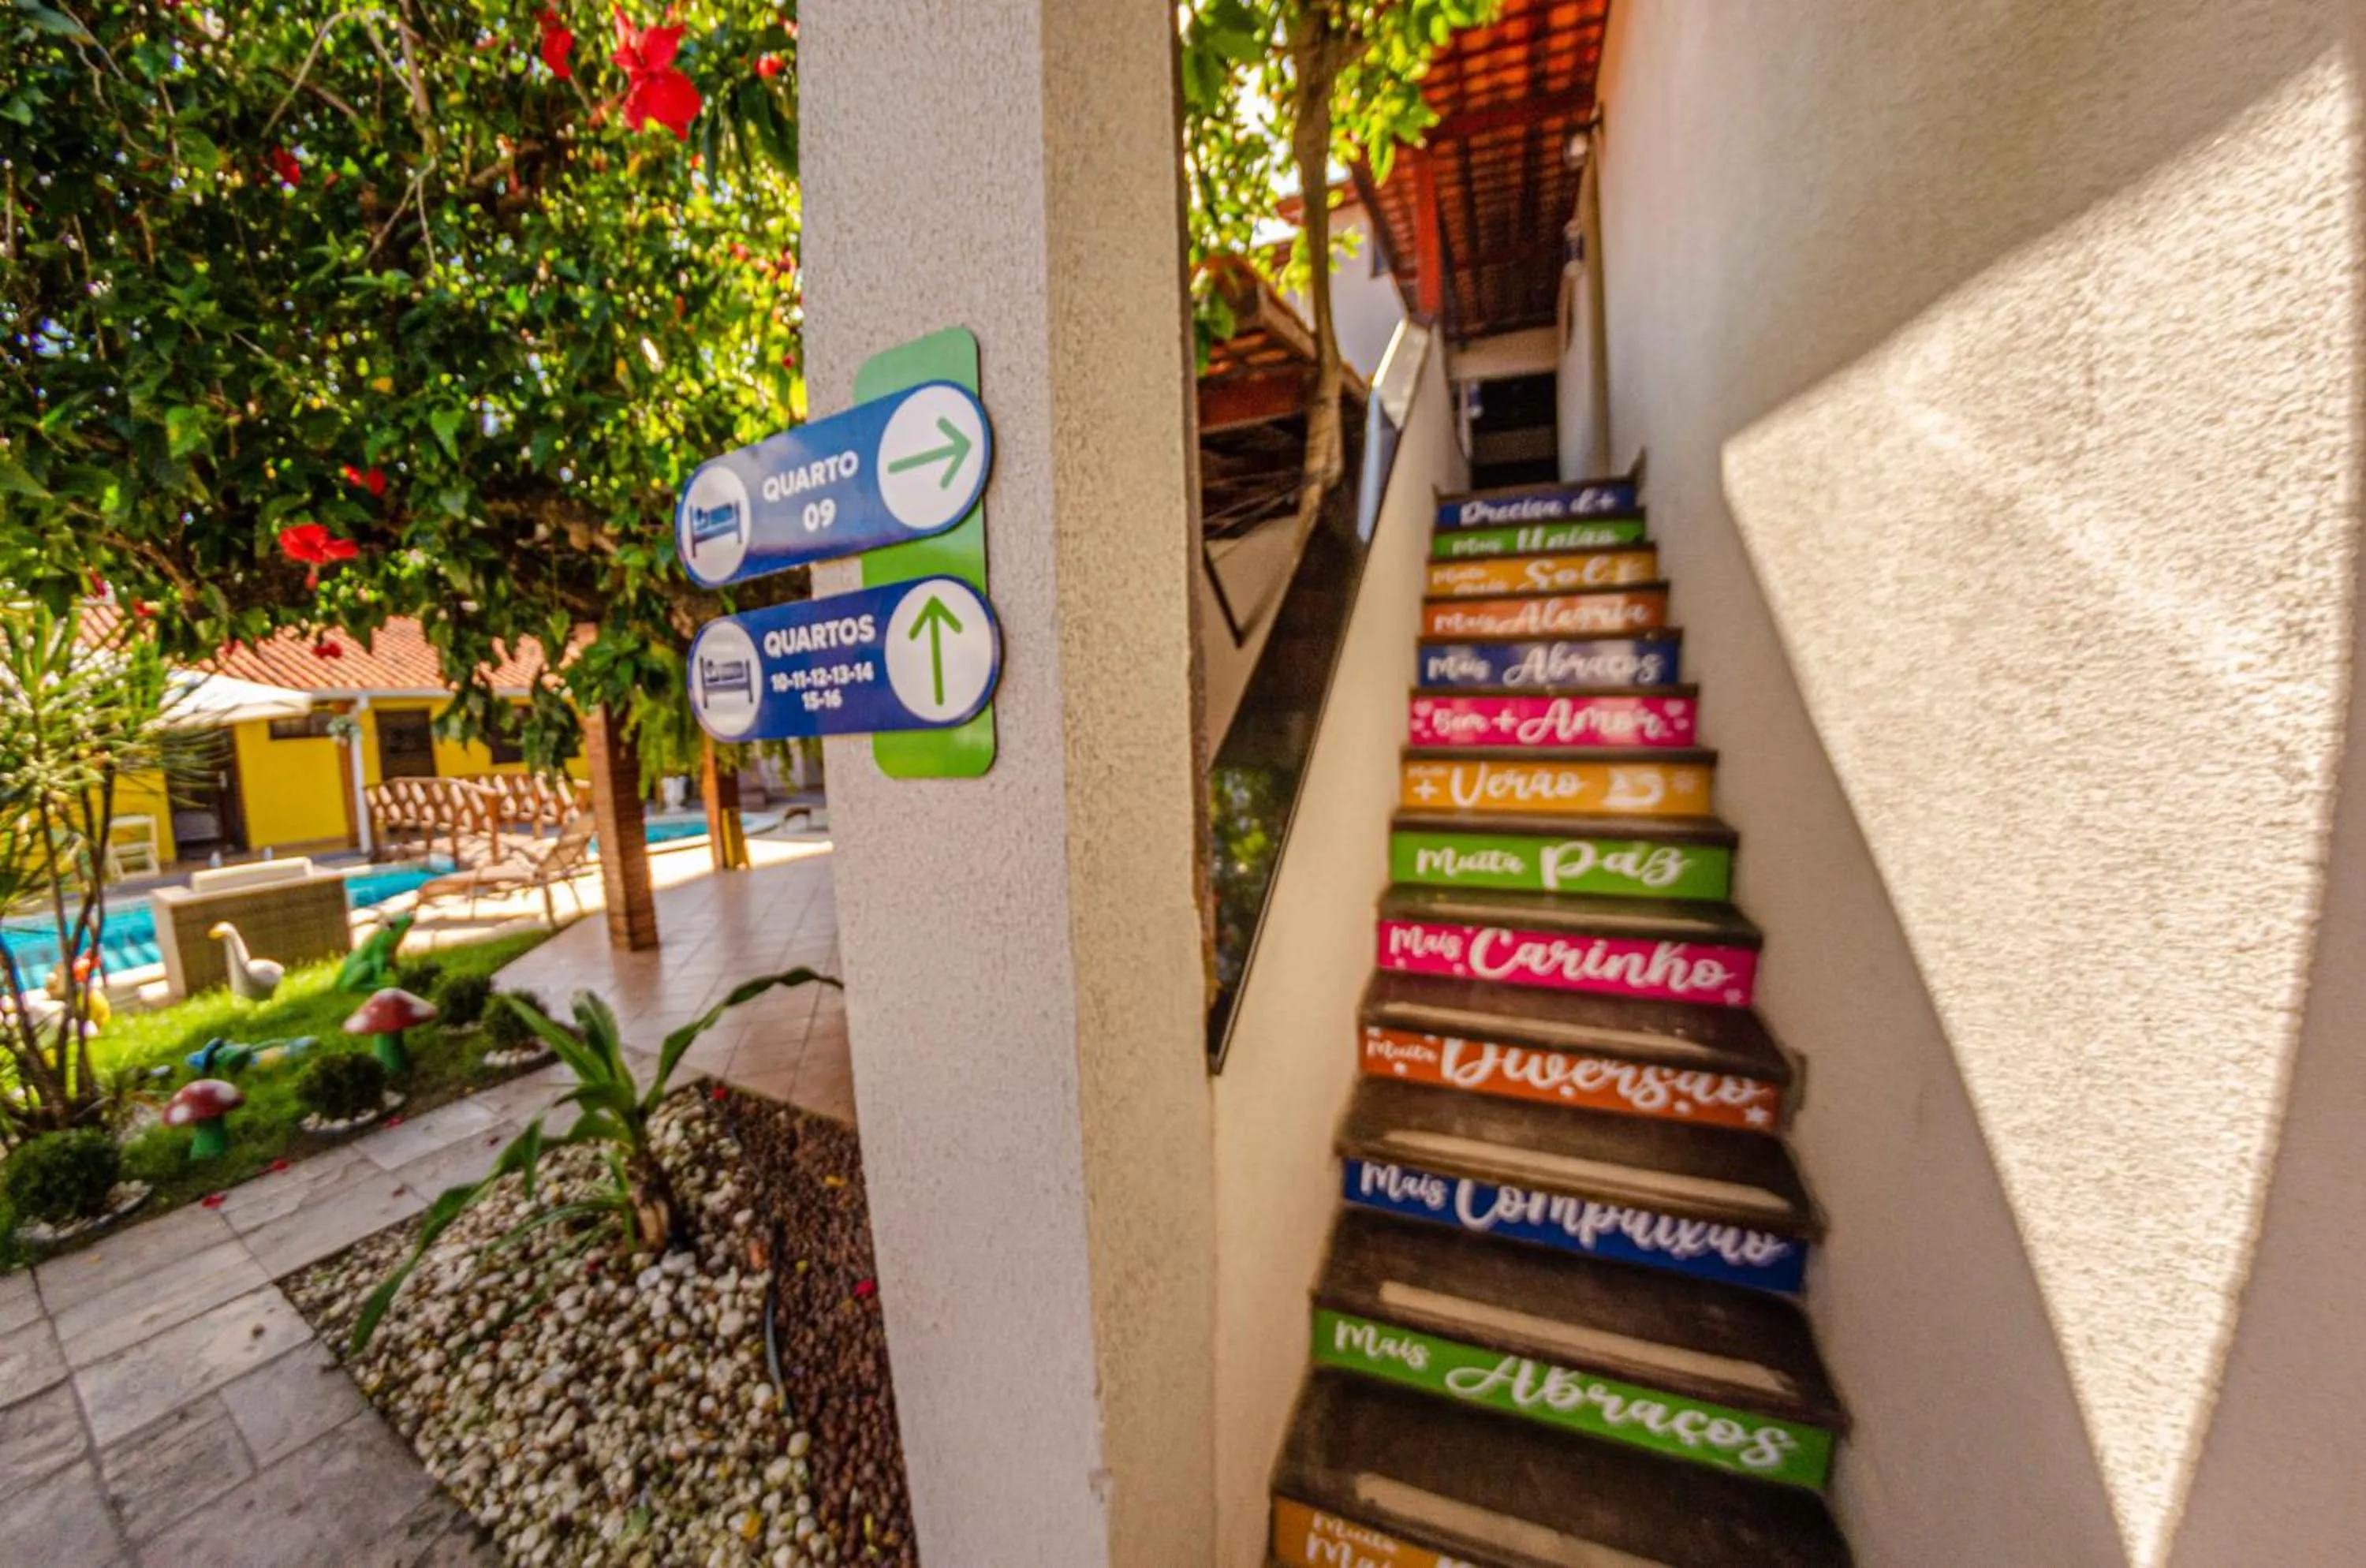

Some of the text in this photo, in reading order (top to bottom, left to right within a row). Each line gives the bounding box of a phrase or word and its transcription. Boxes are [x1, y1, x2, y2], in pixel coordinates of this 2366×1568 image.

[762, 450, 859, 502] QUARTO
[802, 498, 836, 532] 09
[1516, 555, 1610, 592] Sol
[763, 614, 876, 658] QUARTOS
[1497, 597, 1648, 633] Alegria
[1516, 698, 1668, 745] Amor
[1539, 840, 1694, 889] Paz
[1389, 924, 1735, 991] Mais Carinho
[1361, 1159, 1449, 1210] Mais
[1334, 1319, 1797, 1469] Mais Abraços
